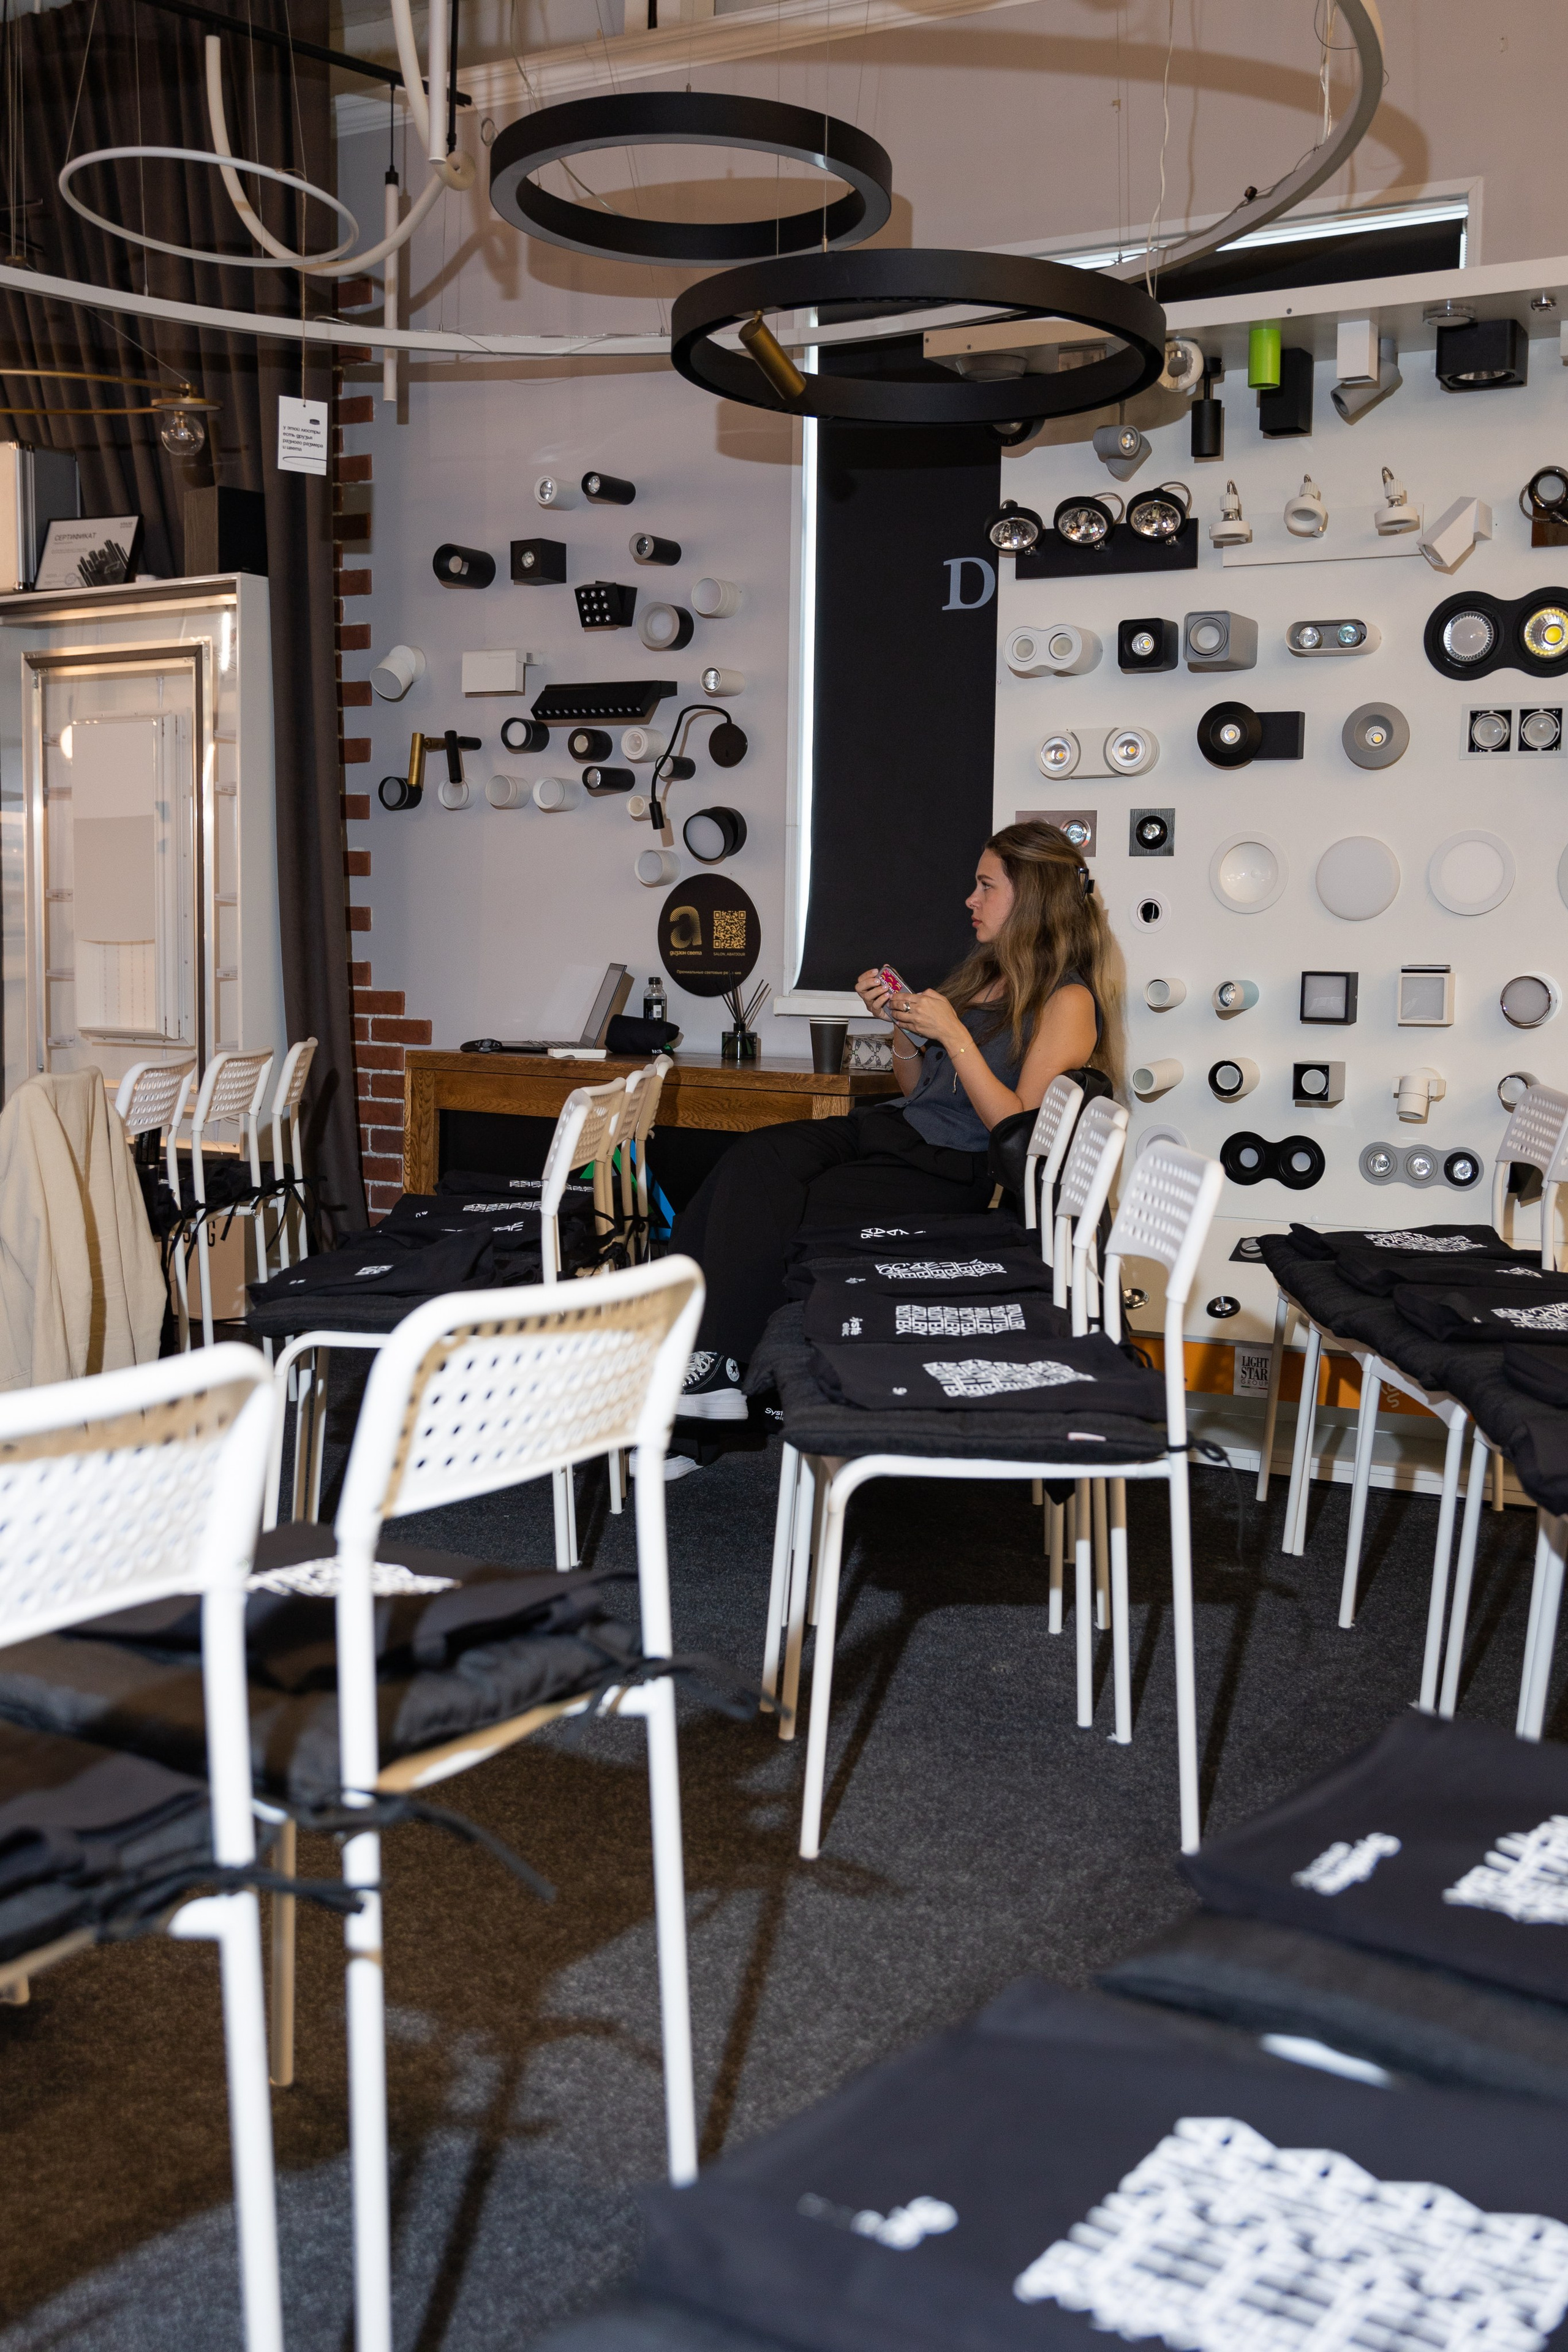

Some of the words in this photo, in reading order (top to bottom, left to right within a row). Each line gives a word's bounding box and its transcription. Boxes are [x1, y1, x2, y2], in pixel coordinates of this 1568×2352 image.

[54, 532, 97, 541] СЕРТИФИКАТ
[941, 556, 996, 611] D
[1241, 1355, 1269, 1369] LIGHT
[1241, 1366, 1268, 1381] STAR
[764, 1407, 784, 1415] Syst
